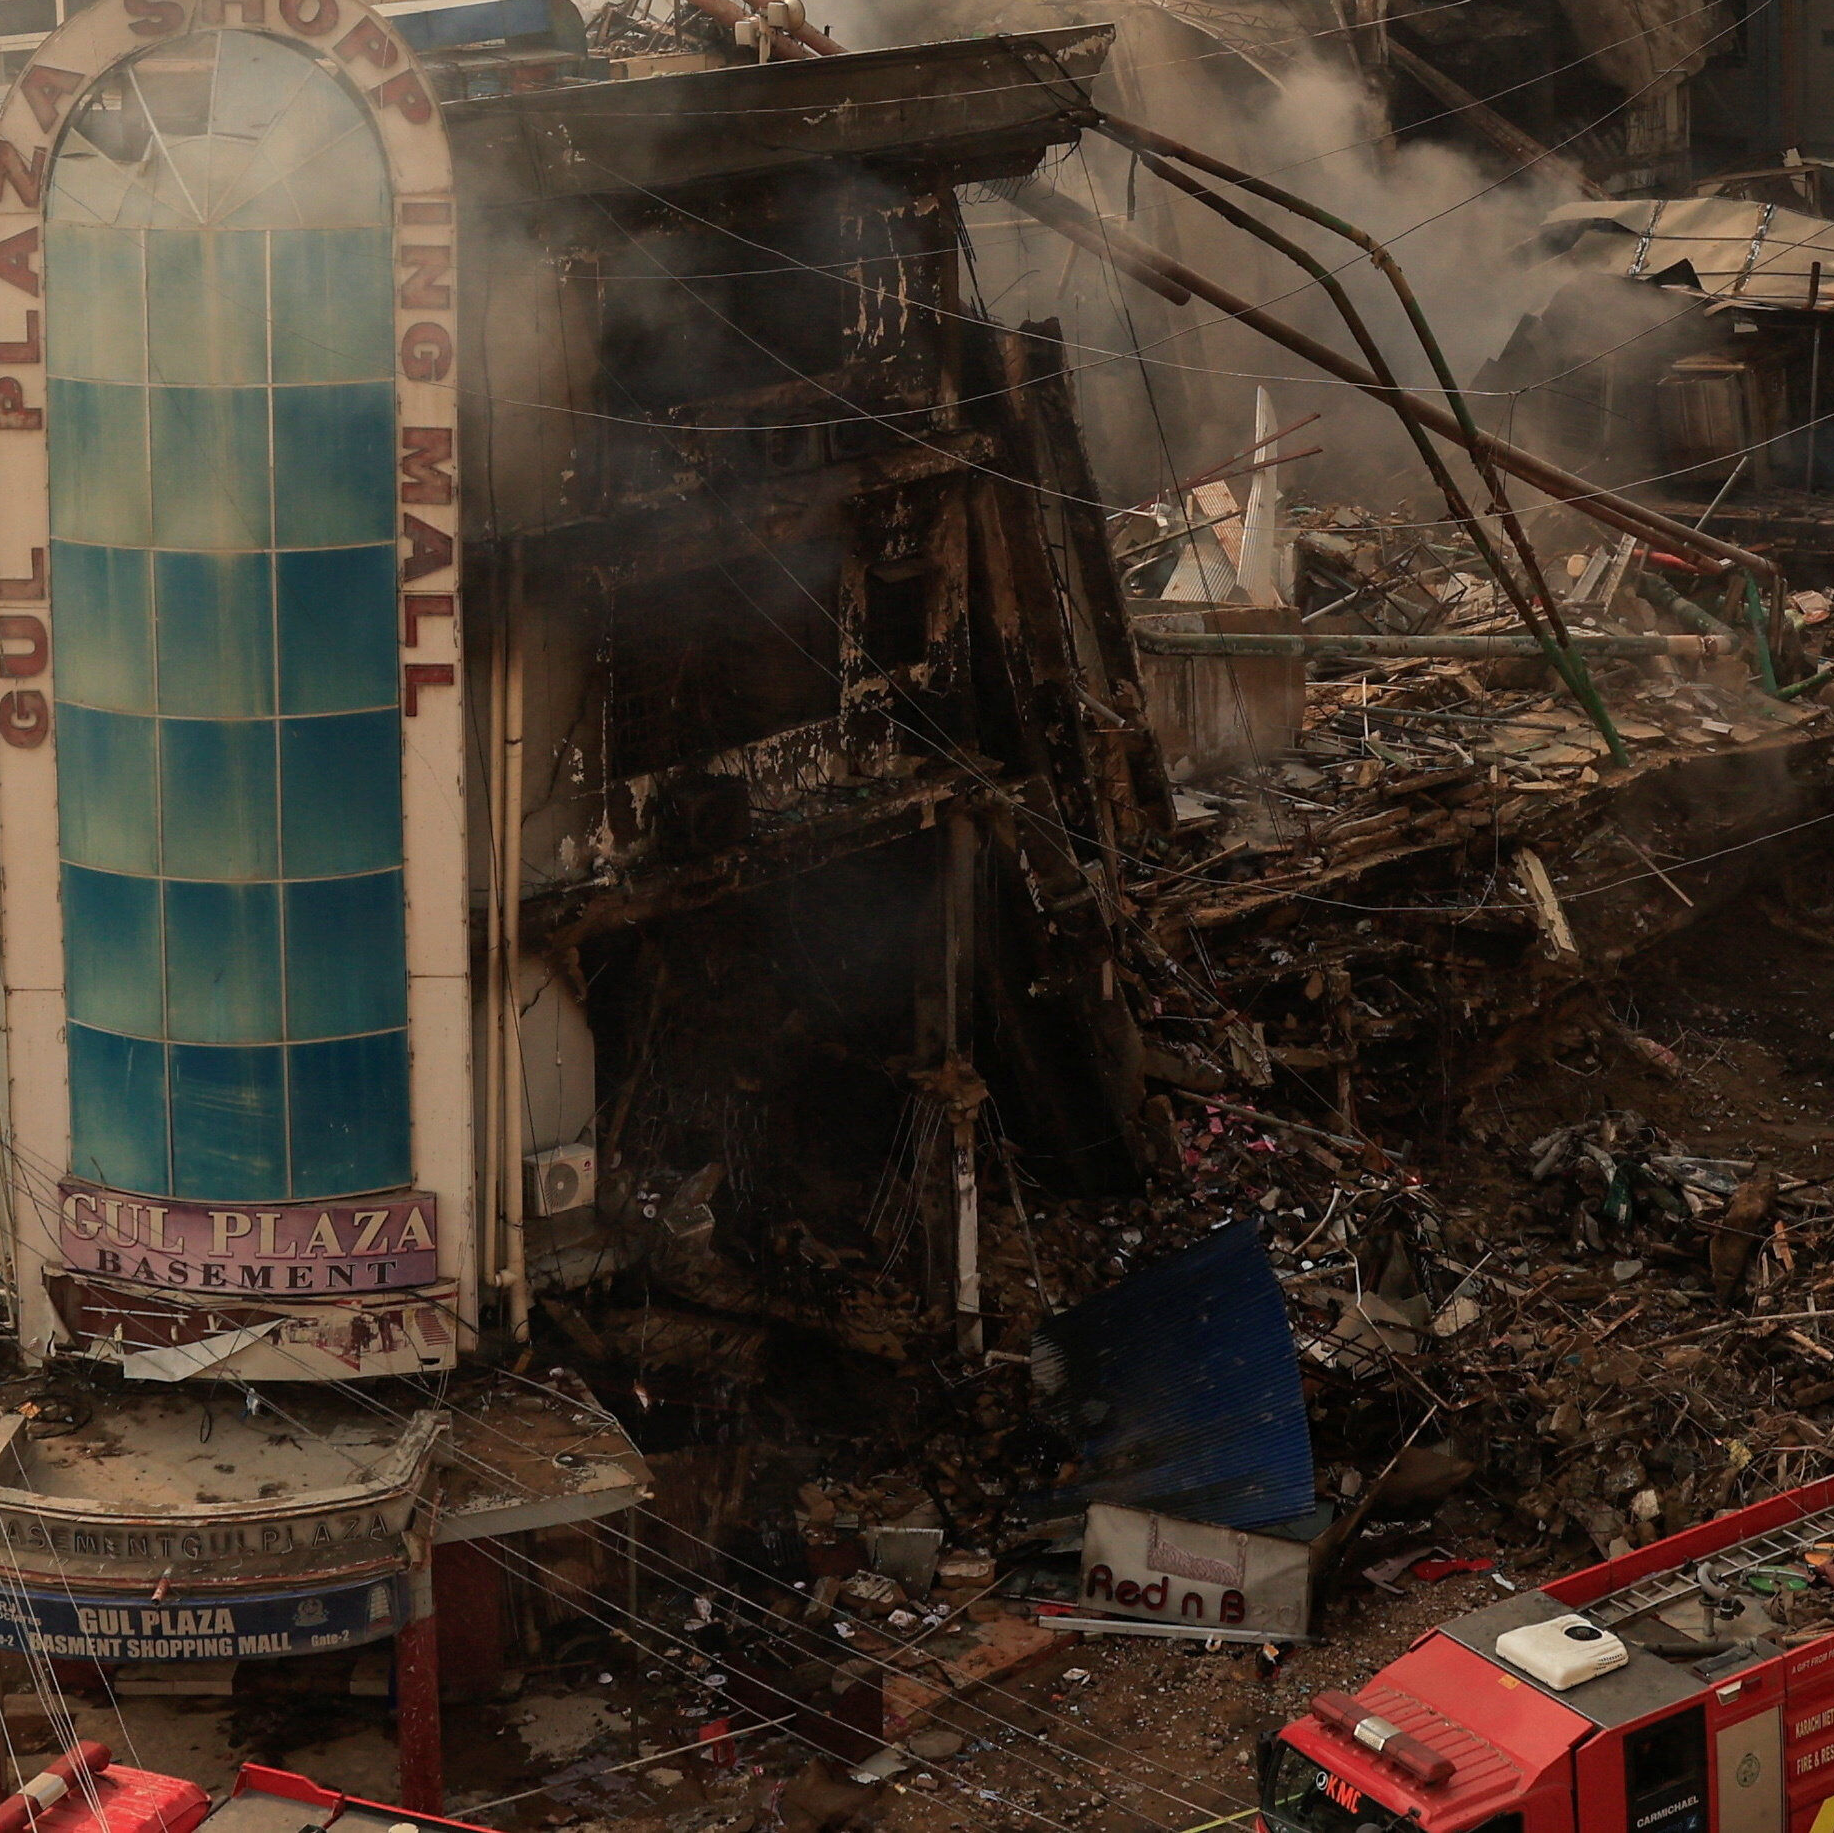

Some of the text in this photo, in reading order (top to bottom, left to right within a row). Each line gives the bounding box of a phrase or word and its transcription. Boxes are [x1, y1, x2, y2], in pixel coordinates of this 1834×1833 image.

[401, 427, 455, 717] MALL
[61, 1193, 436, 1260] GUL PLAZA
[95, 1248, 398, 1290] BASEMENT
[1086, 1563, 1169, 1611] Red
[1181, 1591, 1203, 1619] n
[78, 1607, 235, 1636] GUL PLAZA
[310, 1629, 350, 1647] Gate-2
[30, 1630, 292, 1658] BASMENT SHOPPING MALL
[1795, 1711, 1822, 1739] KARACHI
[1796, 1752, 1813, 1775] FIRE
[1814, 1751, 1820, 1767] &
[1326, 1773, 1362, 1814] KMC
[1636, 1794, 1699, 1828] CARMICHAEL
